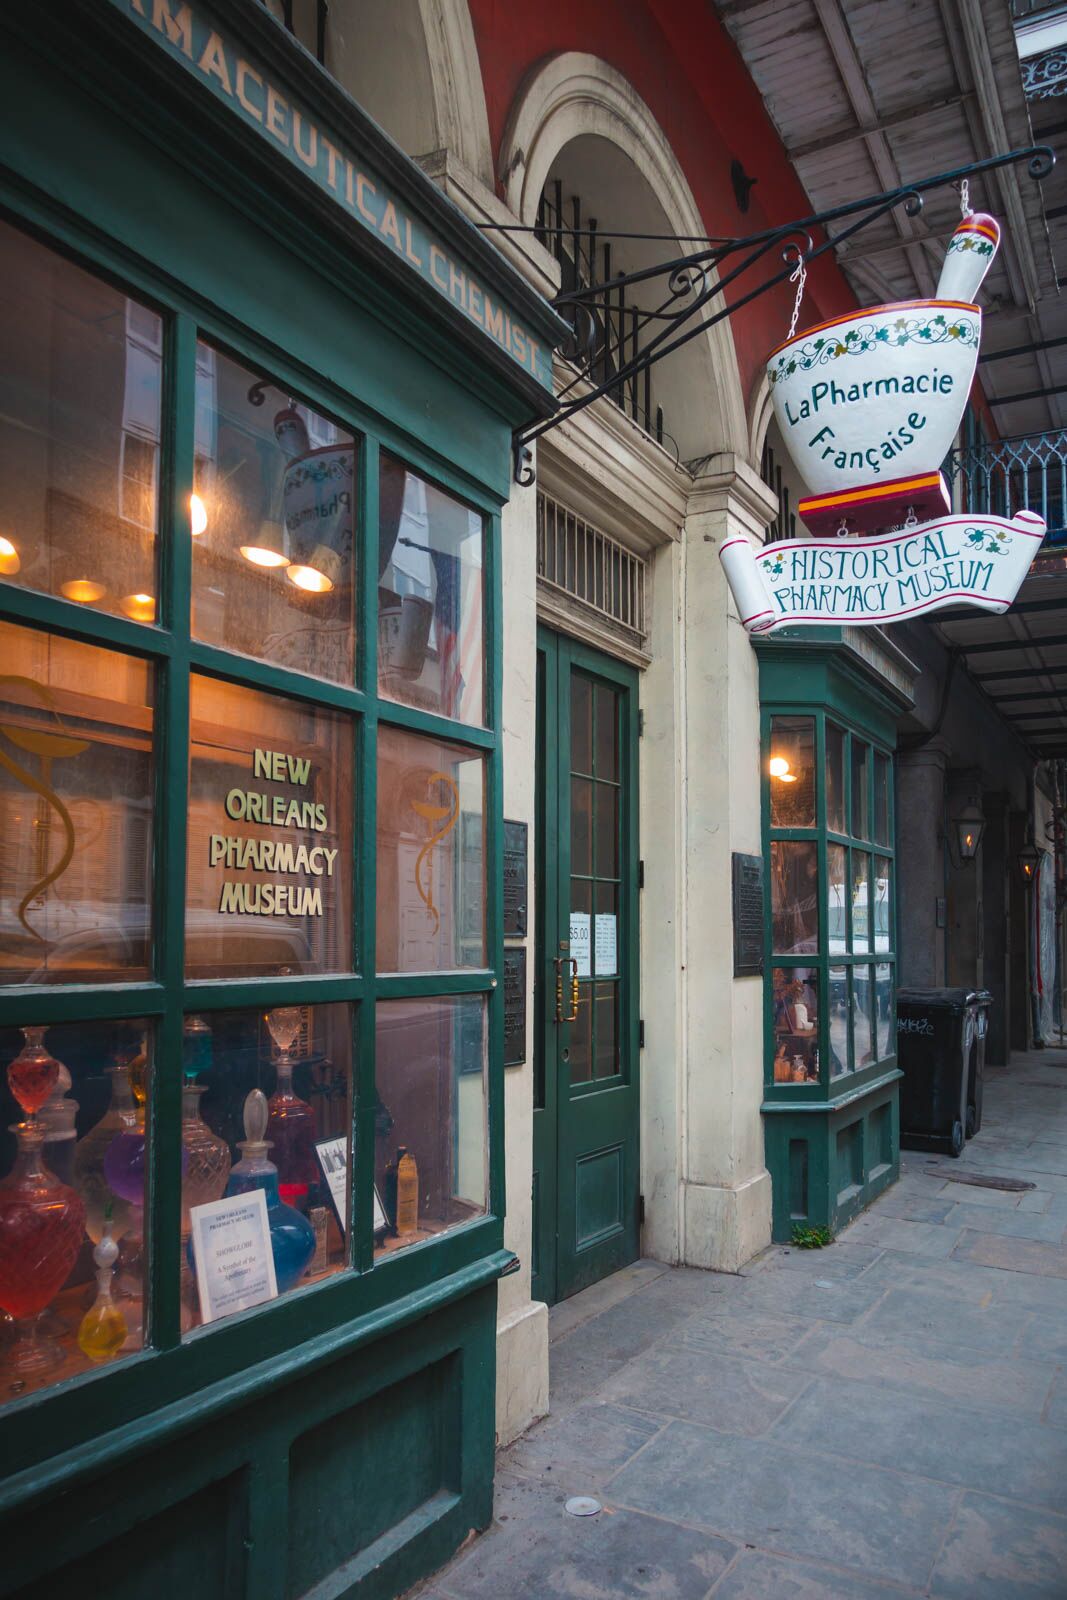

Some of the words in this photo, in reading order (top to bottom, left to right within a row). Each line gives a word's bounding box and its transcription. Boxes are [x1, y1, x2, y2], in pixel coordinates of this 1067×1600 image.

[132, 0, 422, 267] MACEUTICAL
[785, 399, 811, 427] La
[811, 366, 954, 413] Pharmacie
[808, 411, 927, 474] Française
[790, 530, 960, 583] HISTORICAL
[773, 582, 891, 615] PHARMACY
[897, 560, 995, 606] MUSEUM
[253, 748, 311, 786] NEW
[225, 788, 328, 832] ORLEANS
[209, 834, 338, 876] PHARMACY
[219, 882, 323, 916] MUSEUM
[569, 926, 589, 940] $5.00
